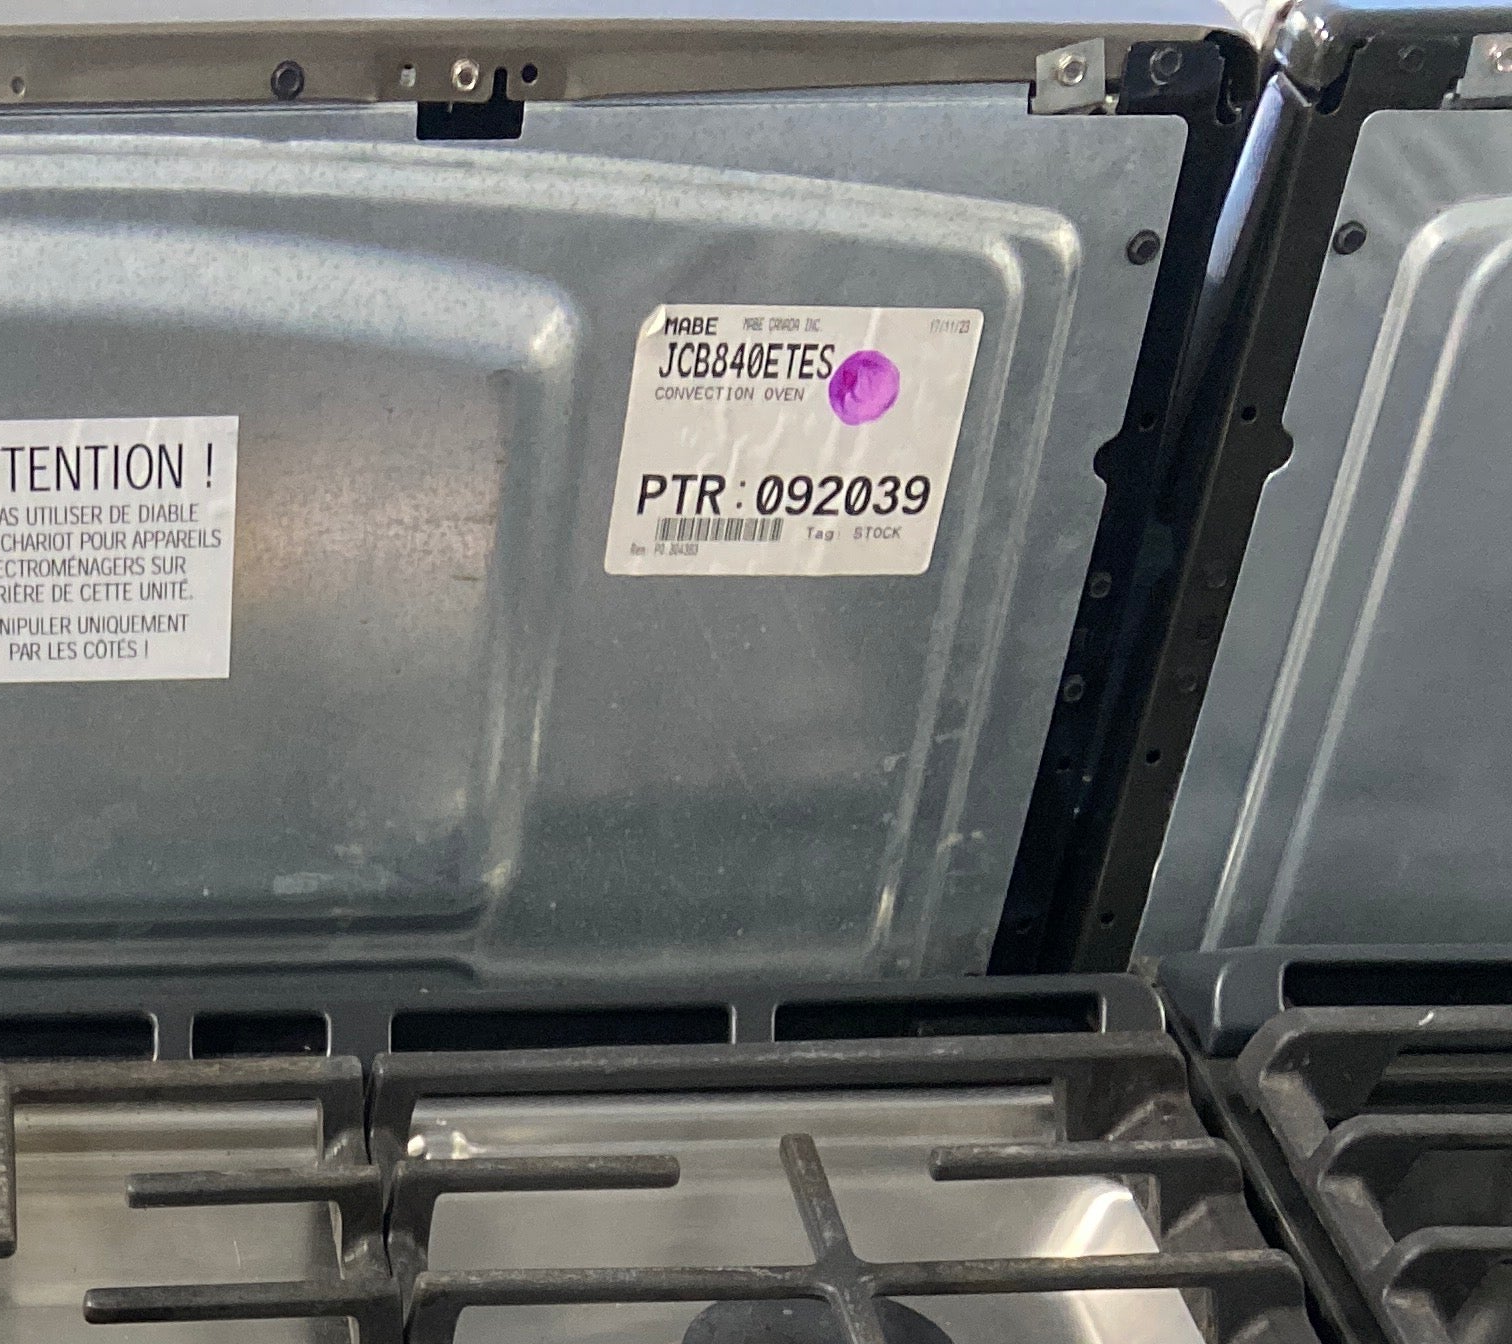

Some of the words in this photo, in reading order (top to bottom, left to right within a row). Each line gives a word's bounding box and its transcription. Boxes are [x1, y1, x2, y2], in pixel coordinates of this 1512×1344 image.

[664, 317, 718, 335] MABE
[659, 343, 835, 379] JCB840ETES
[655, 387, 754, 401] CONVECTION
[764, 387, 804, 401] OVEN
[26, 506, 102, 525] UTILISER
[109, 505, 130, 523] DE
[139, 503, 199, 522] DIABLE
[1, 532, 75, 552] CHARIOT
[80, 531, 127, 550] POUR
[132, 529, 221, 549] APPAREILS
[854, 526, 901, 539] STOCK
[151, 556, 186, 575] SUR
[52, 584, 73, 602] DE
[80, 583, 132, 602] CETTE
[140, 578, 193, 601] UNITÉ.
[78, 614, 189, 634] UNIQUEMENT
[9, 642, 40, 661] PAR
[48, 641, 77, 660] LES
